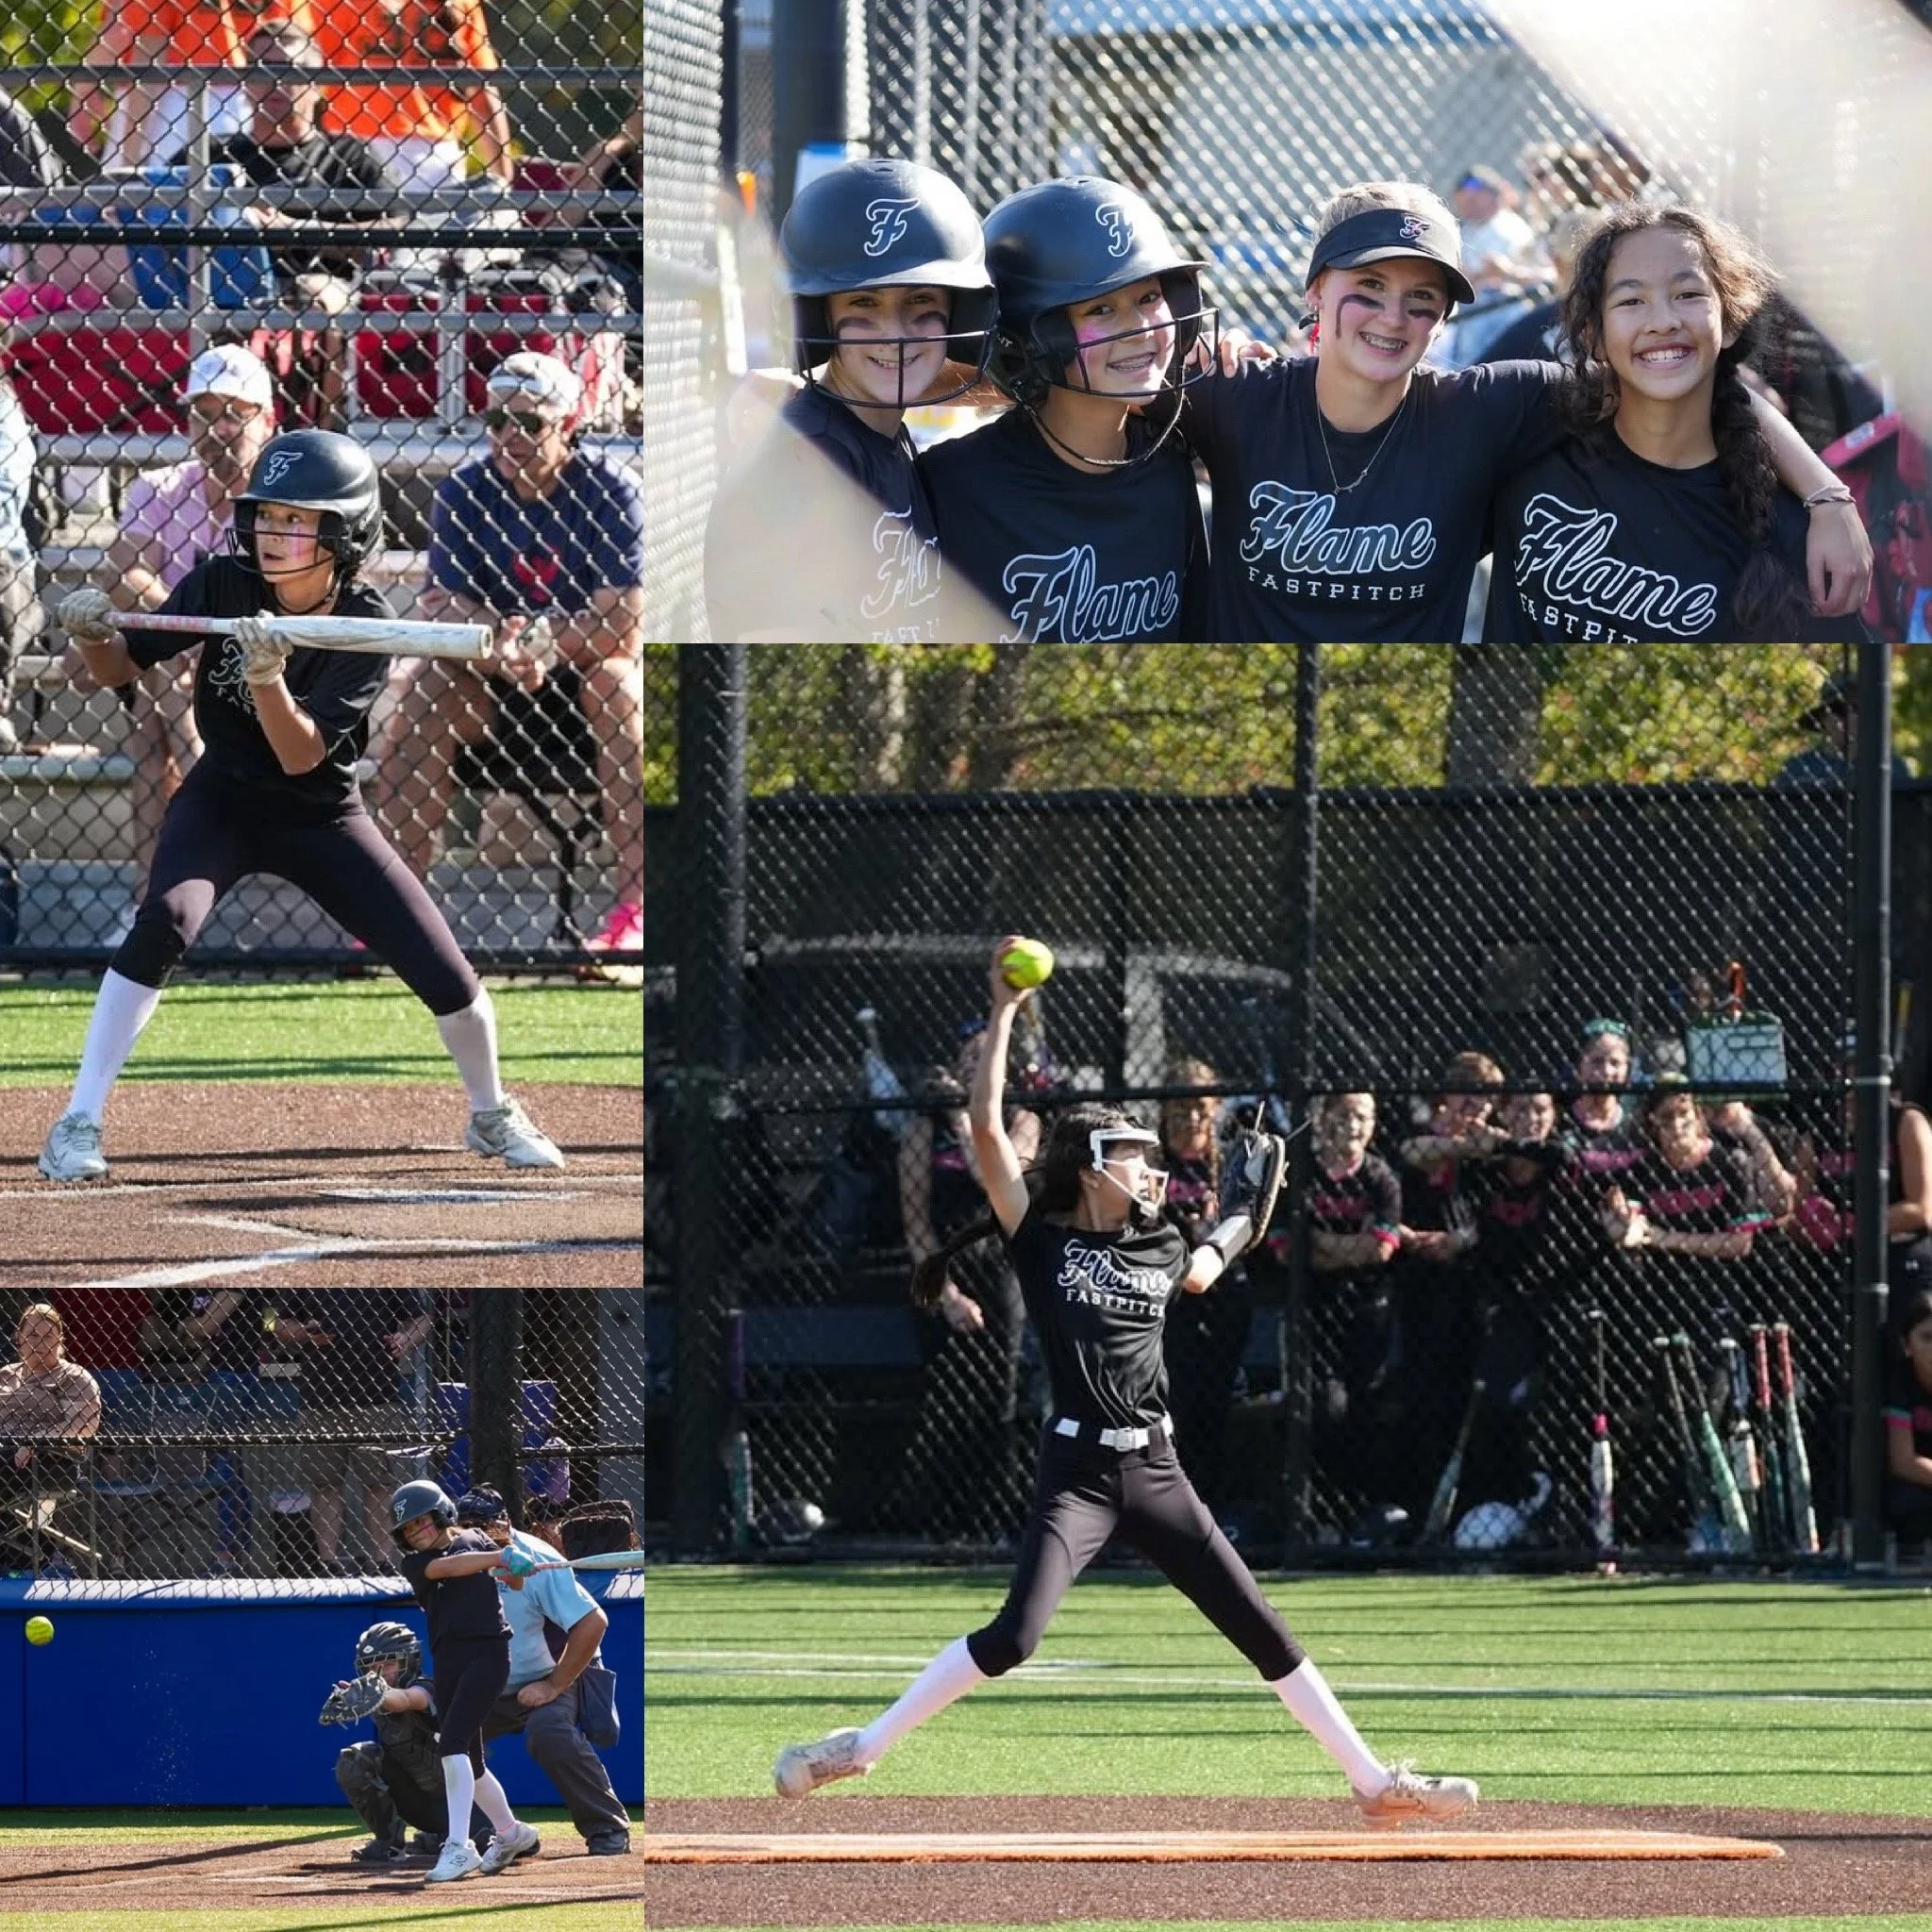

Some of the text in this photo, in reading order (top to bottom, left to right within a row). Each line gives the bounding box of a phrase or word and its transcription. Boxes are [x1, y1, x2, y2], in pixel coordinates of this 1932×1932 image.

[864, 197, 922, 257] F
[264, 450, 304, 486] F
[860, 505, 941, 619] Fla
[1240, 480, 1437, 575] Flame
[1514, 492, 1718, 636] Flame
[1000, 544, 1178, 643] Flame
[1248, 566, 1425, 600] FASTPITCH
[1520, 592, 1638, 643] FASTPI
